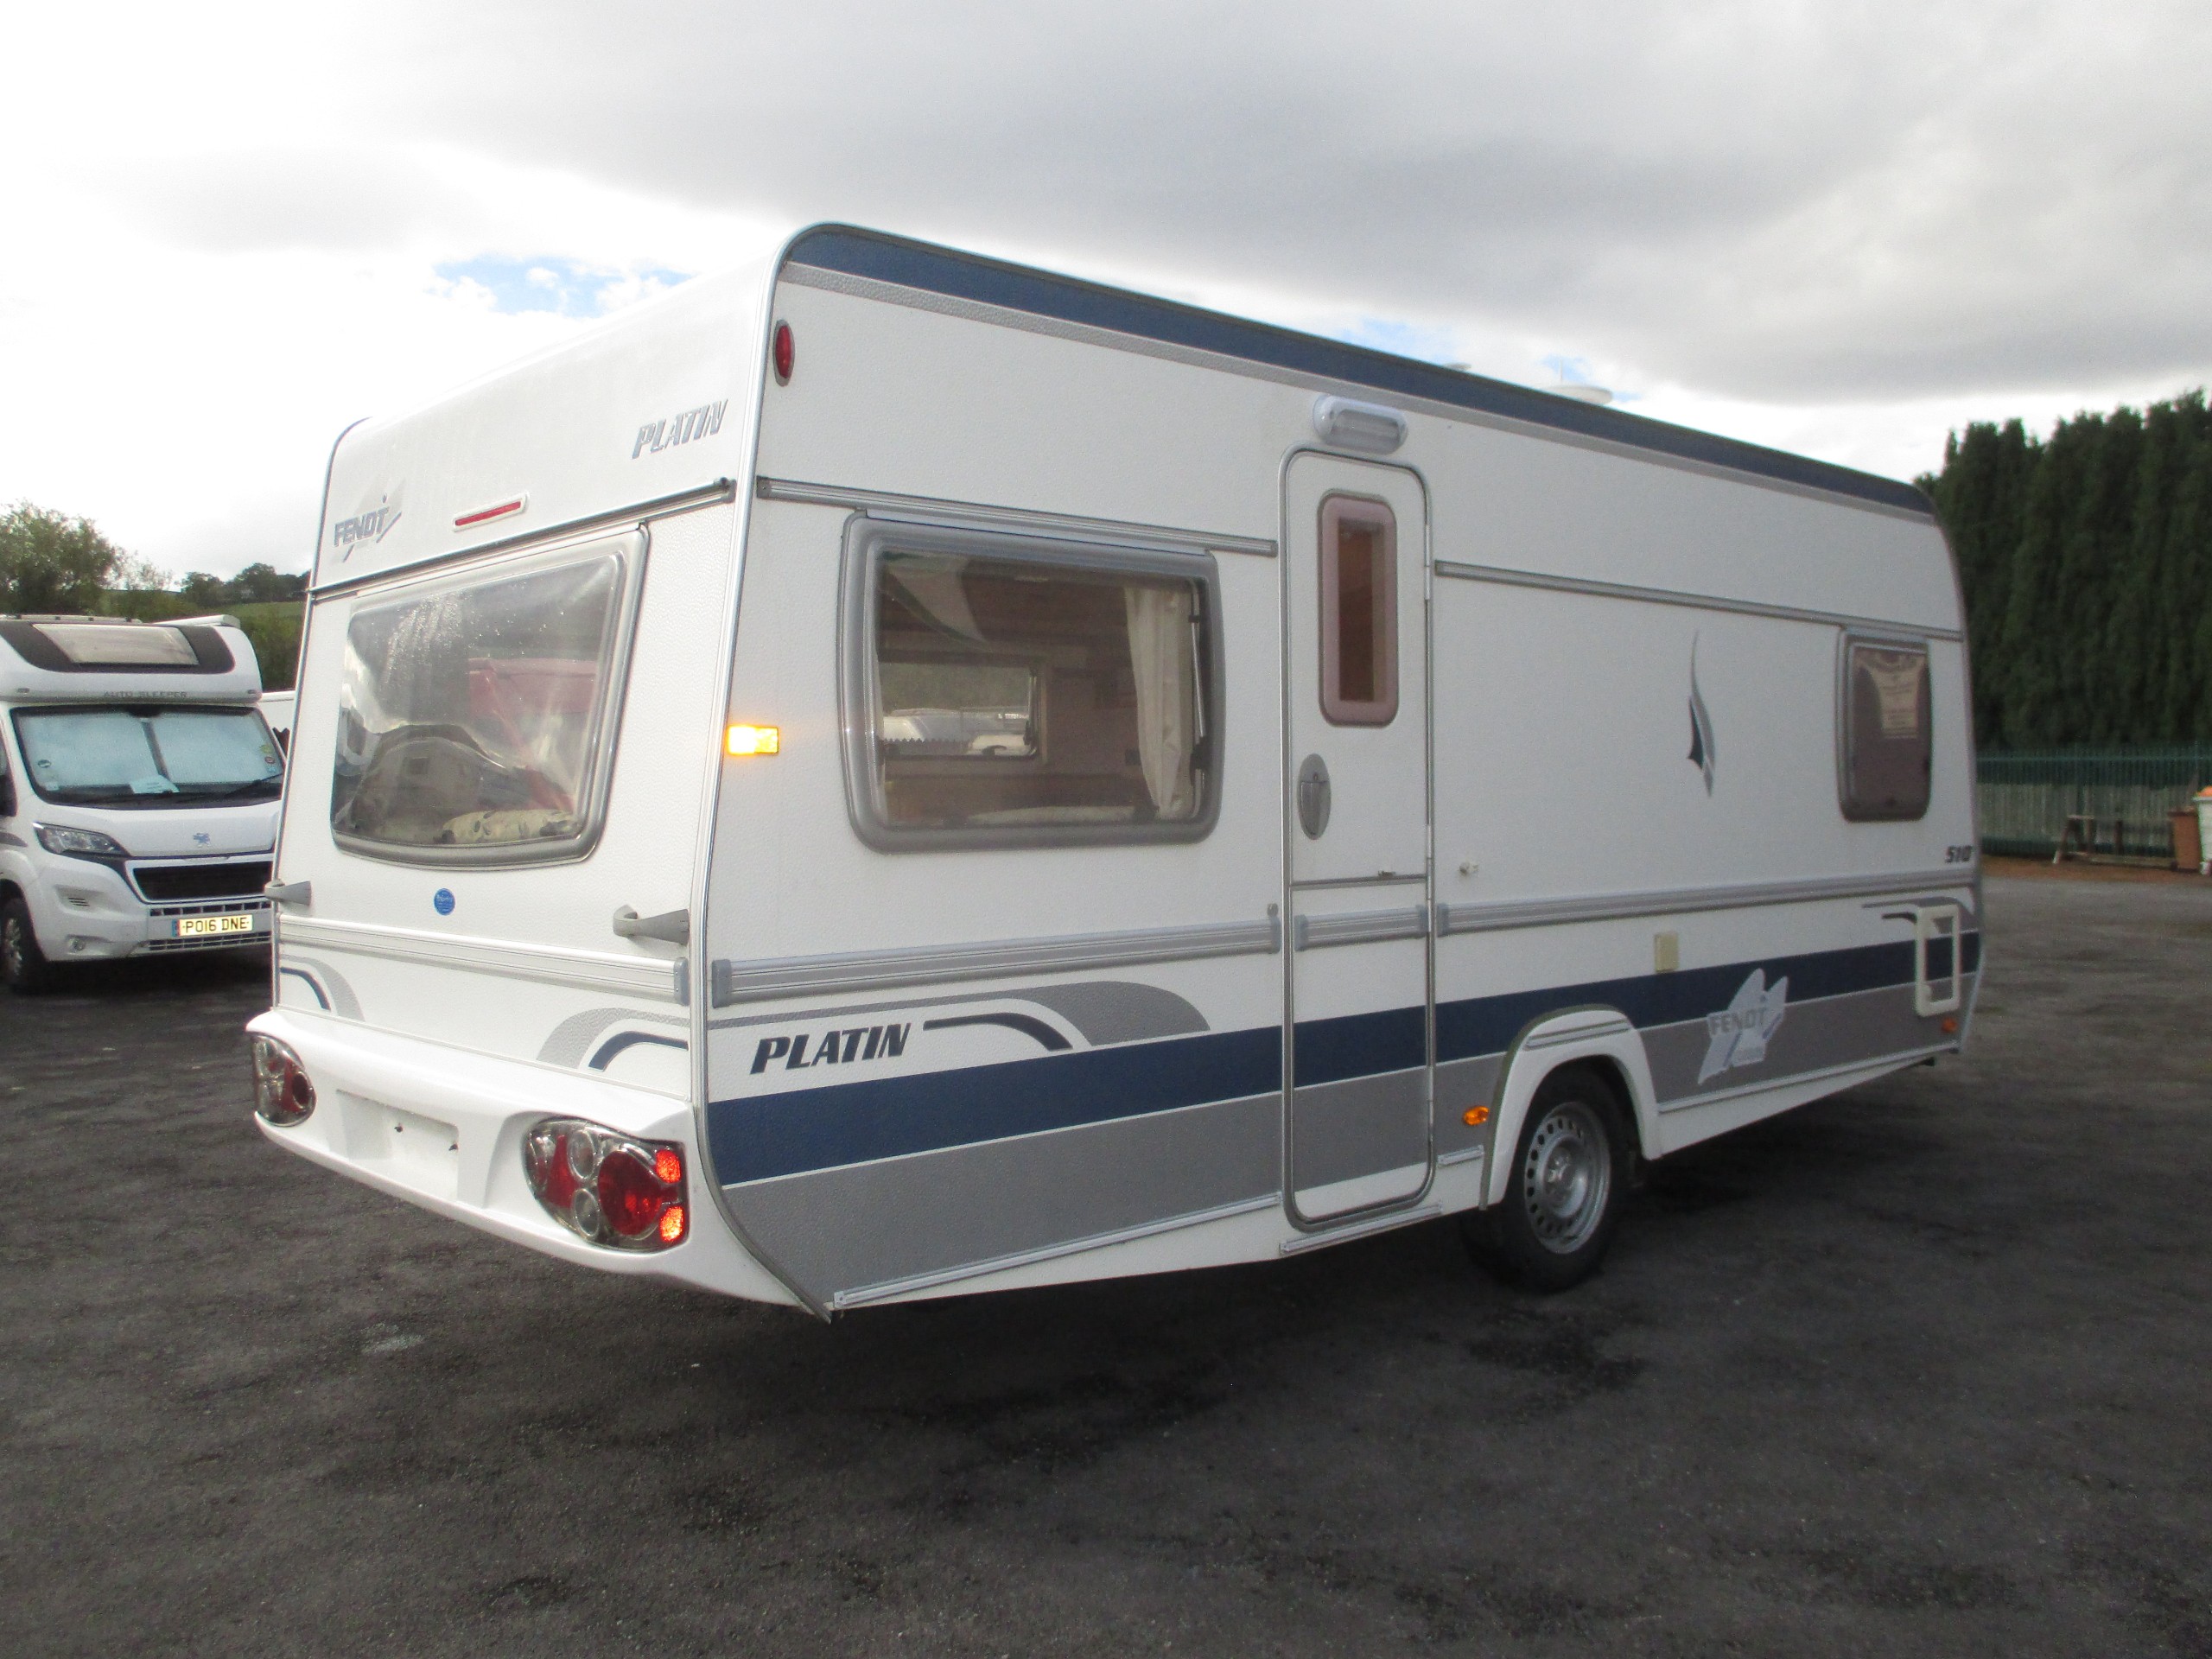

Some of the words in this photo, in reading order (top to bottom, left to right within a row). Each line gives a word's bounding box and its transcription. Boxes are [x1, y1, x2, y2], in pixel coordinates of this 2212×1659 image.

[632, 398, 728, 460] PLATIN
[334, 506, 389, 548] FENDT
[104, 690, 134, 699] AUTO
[138, 690, 188, 699] SLEEPER
[1944, 845, 1973, 863] 510
[185, 918, 217, 933] PO16
[221, 917, 248, 931] DNE
[1709, 1007, 1768, 1036] FENDT
[749, 1022, 912, 1075] PLATIN
